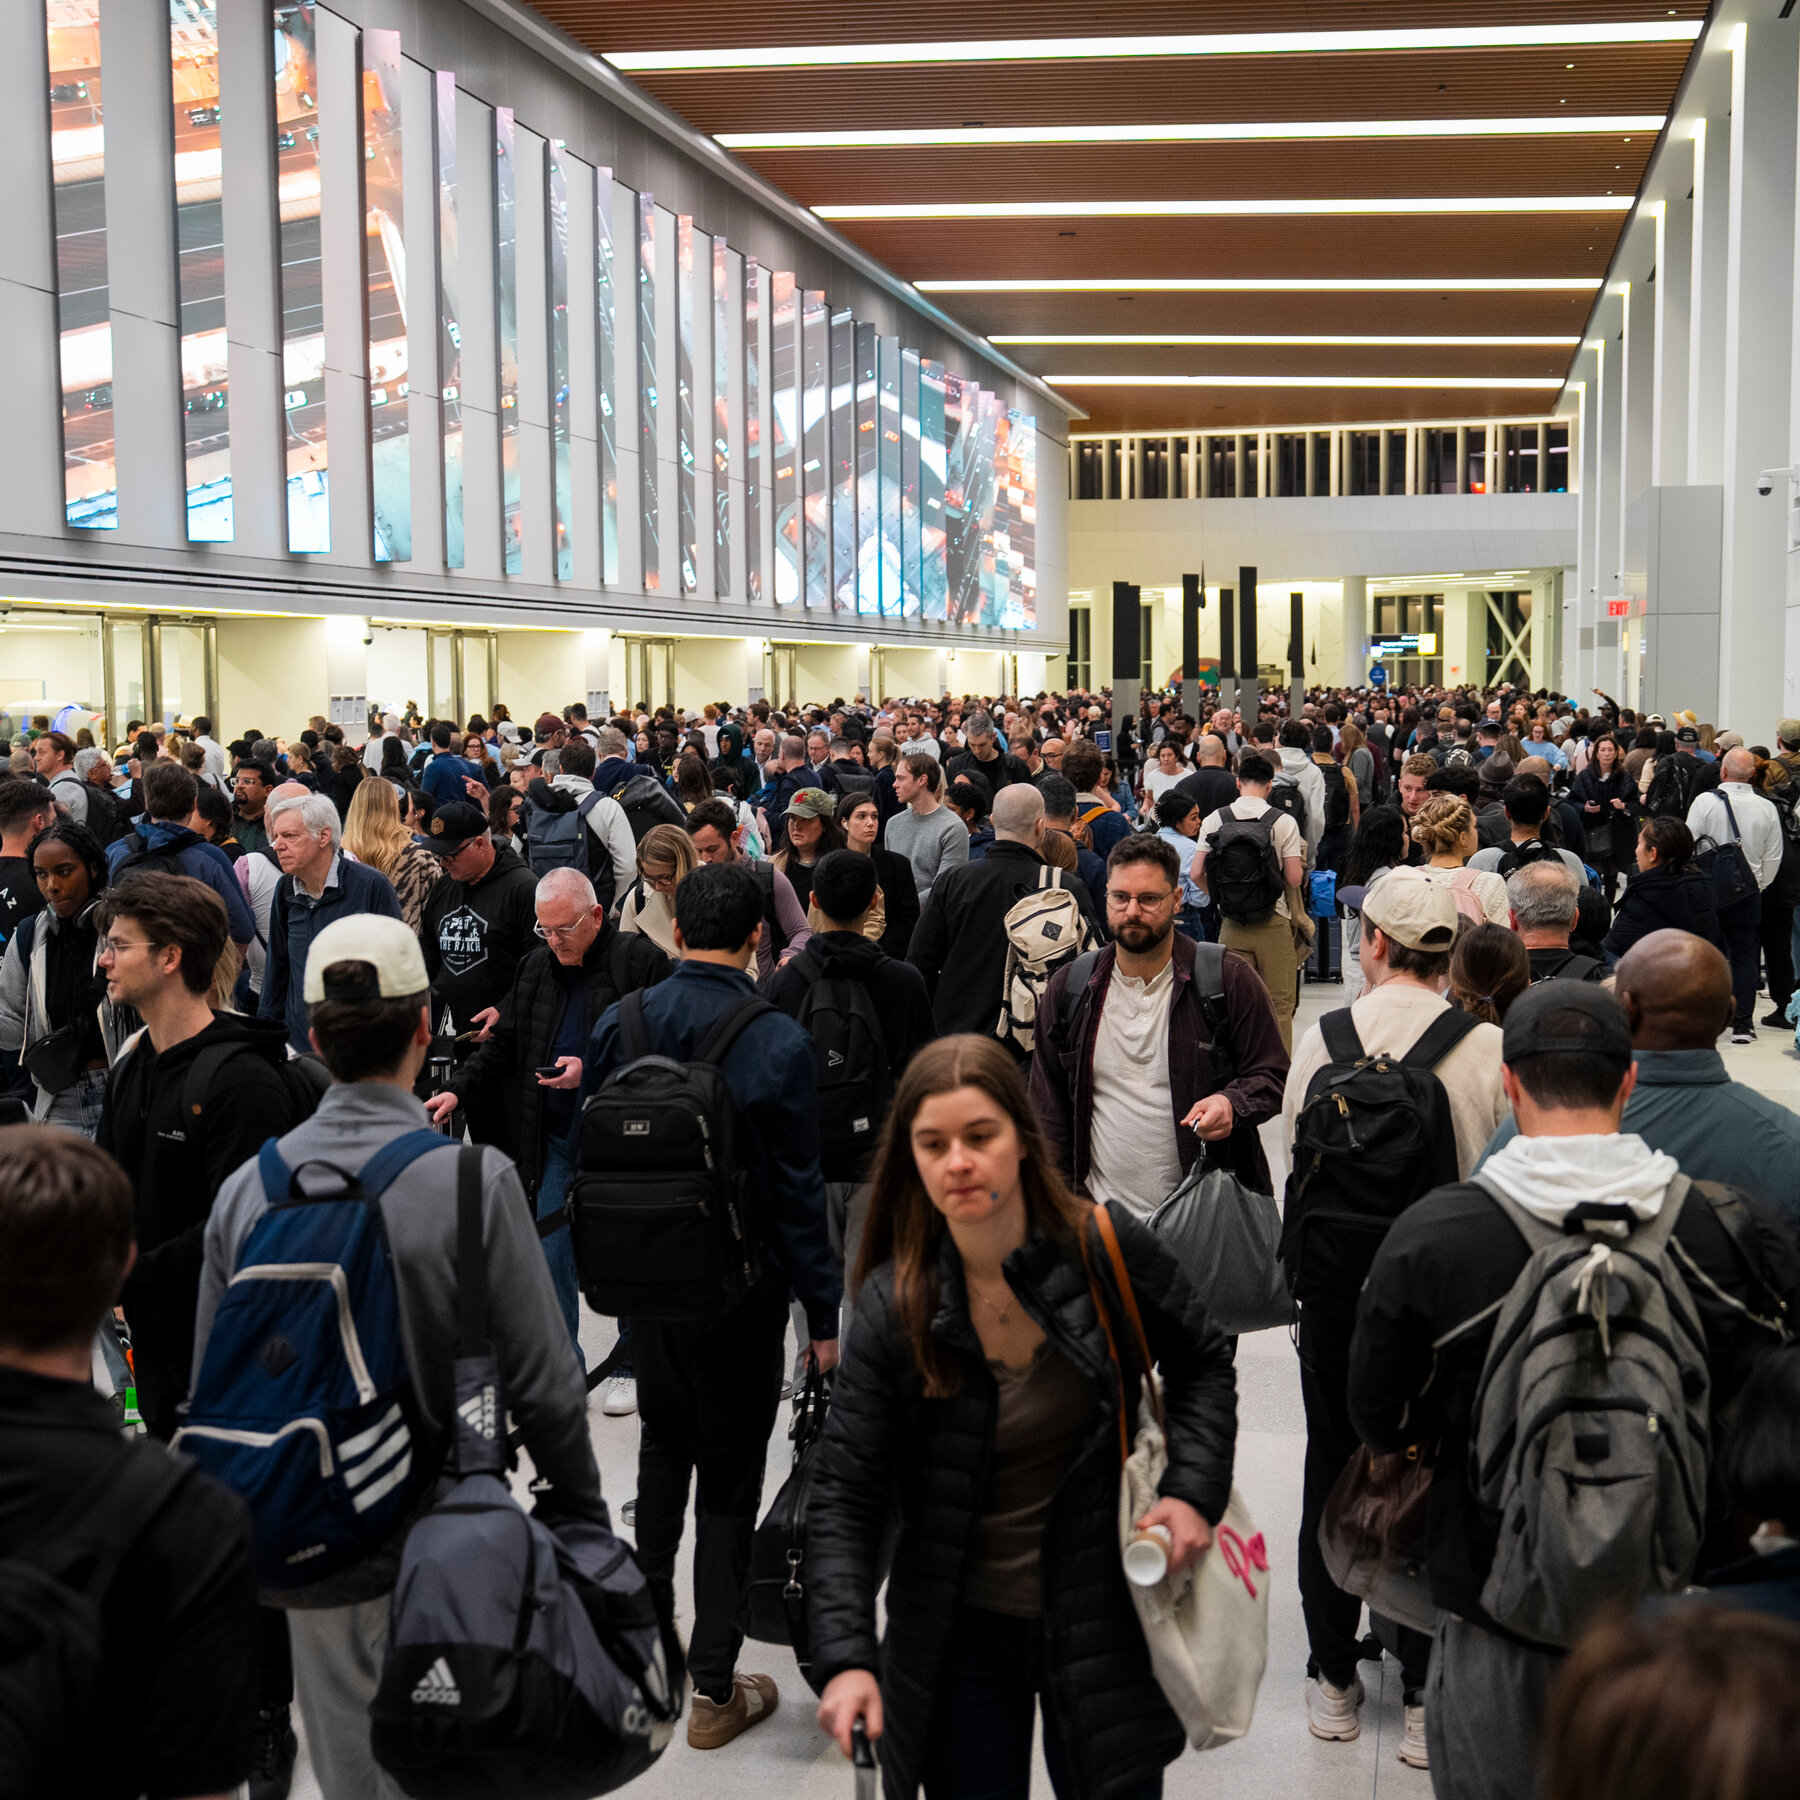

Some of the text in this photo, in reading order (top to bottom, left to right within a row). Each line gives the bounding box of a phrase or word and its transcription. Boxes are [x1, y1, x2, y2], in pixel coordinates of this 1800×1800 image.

[1608, 600, 1629, 616] EXIT
[440, 939, 451, 951] THE
[411, 1689, 461, 1705] adidas
